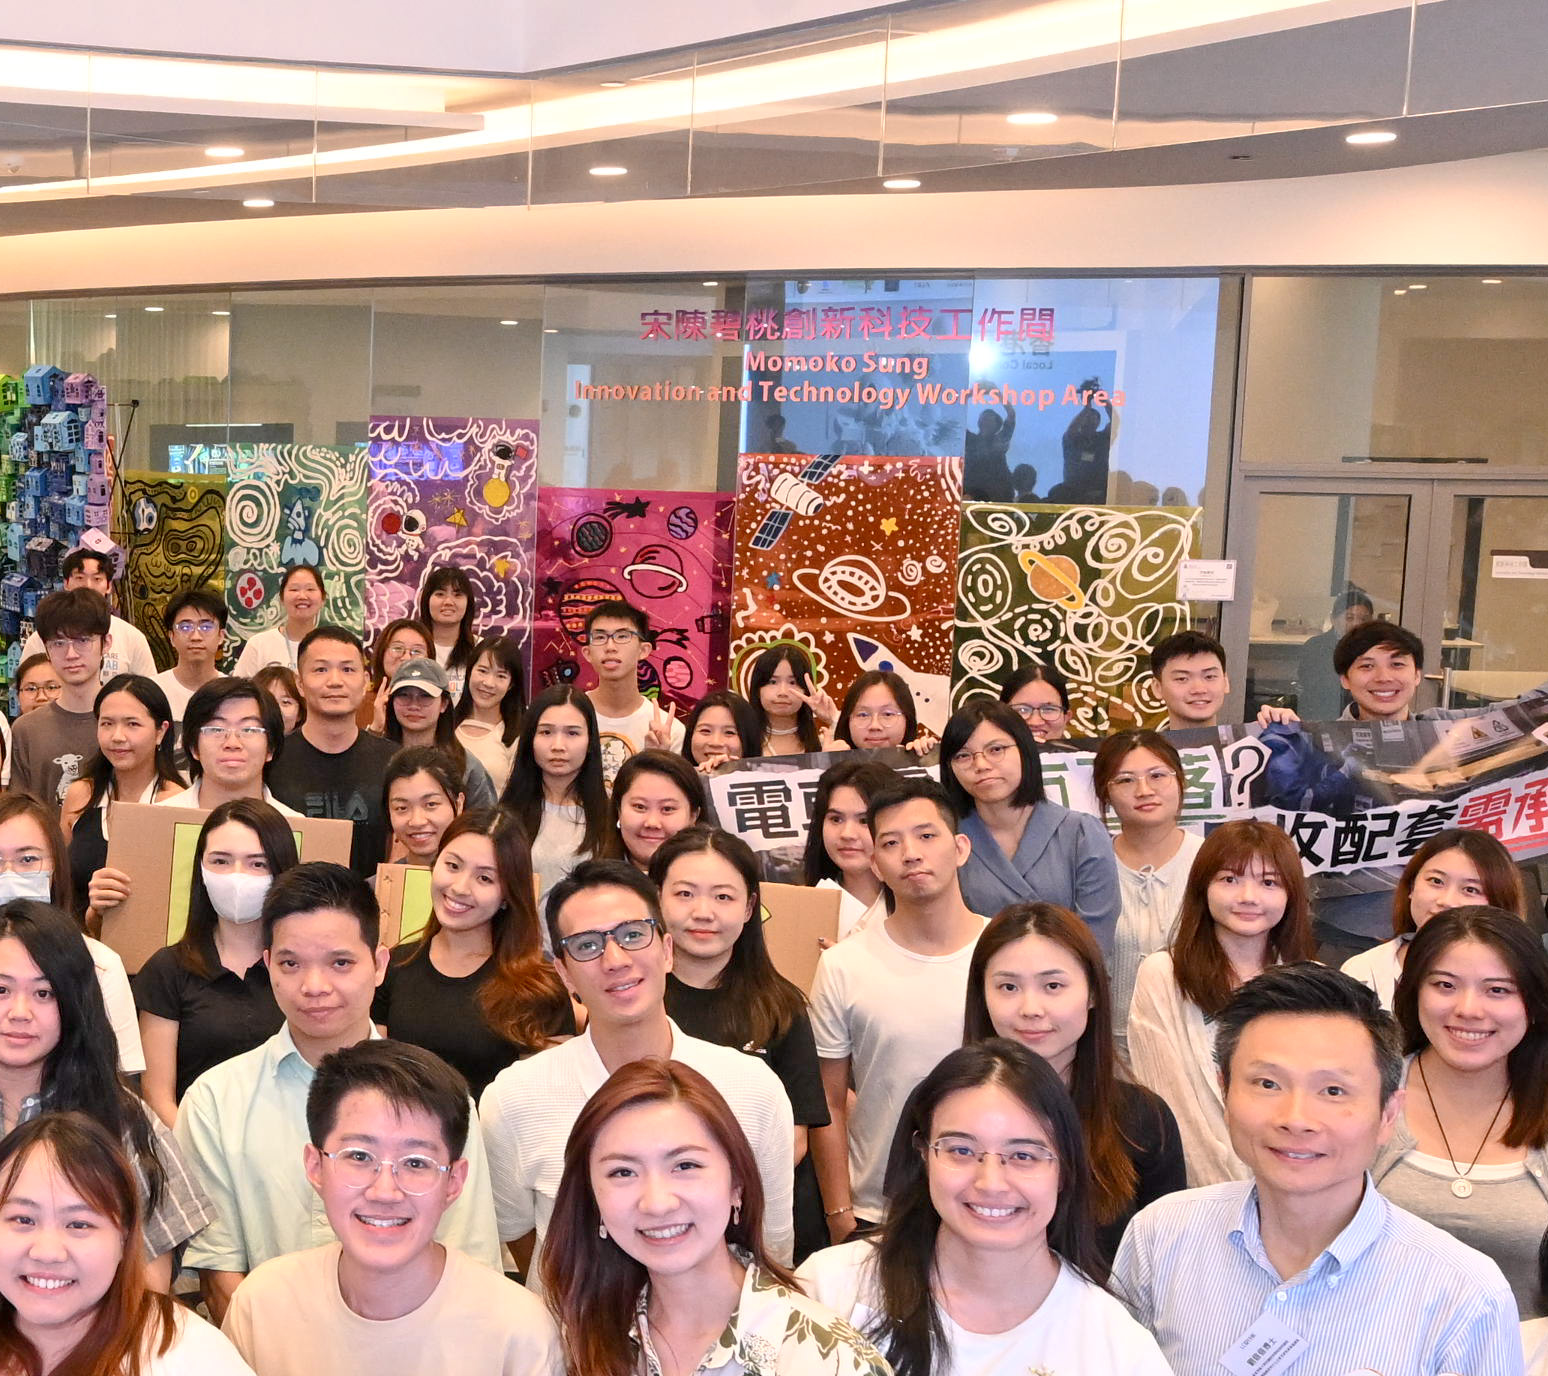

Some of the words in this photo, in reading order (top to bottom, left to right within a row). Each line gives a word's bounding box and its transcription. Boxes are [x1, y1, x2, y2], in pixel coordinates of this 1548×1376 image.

[745, 349, 856, 374] Momoko
[862, 351, 929, 379] Sung
[575, 380, 701, 402] Innovation
[708, 380, 751, 403] and
[759, 381, 908, 409] Technology
[917, 383, 1057, 411] Workshop
[1062, 384, 1126, 407] Area
[305, 791, 368, 821] FILA
